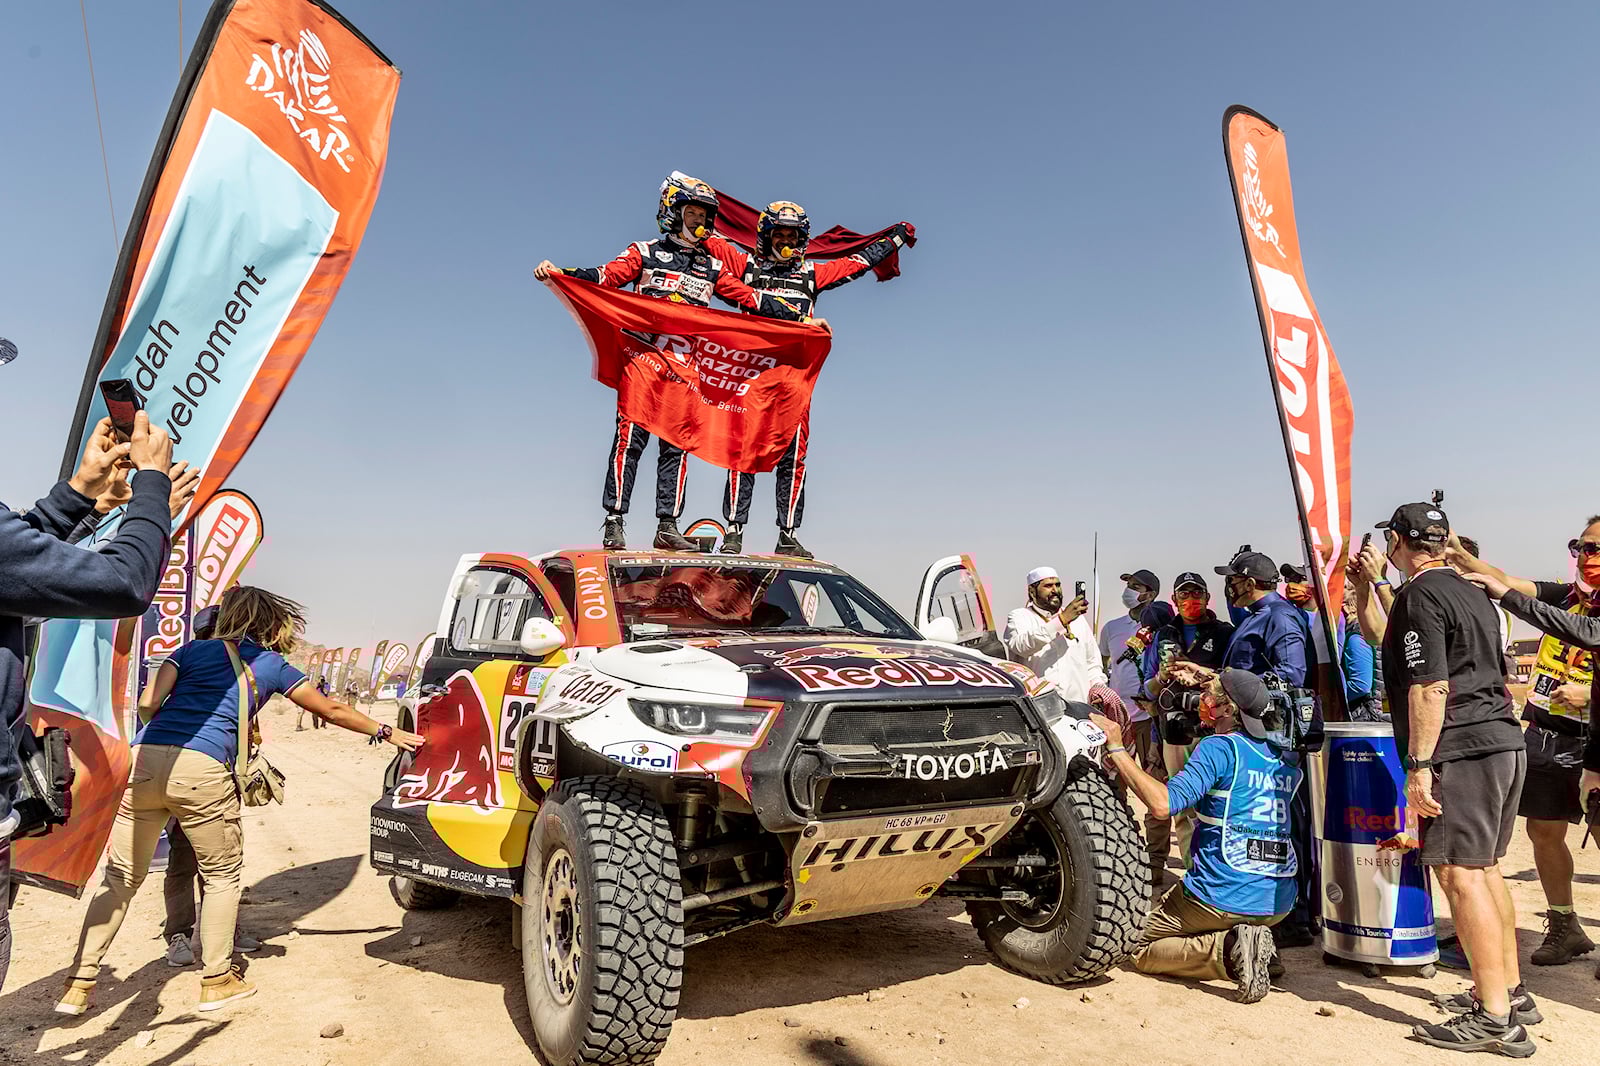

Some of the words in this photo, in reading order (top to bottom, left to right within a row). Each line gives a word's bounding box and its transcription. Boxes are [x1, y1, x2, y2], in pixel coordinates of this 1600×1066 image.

[245, 53, 351, 173] DAKAR
[651, 276, 679, 290] GR
[696, 336, 777, 369] TOYOTA
[623, 346, 662, 372] Pushing
[665, 367, 683, 384] the
[717, 401, 748, 414] Better
[197, 511, 245, 611] MOTUL
[656, 558, 723, 566] TOYOTA
[726, 559, 782, 568] GAZOO
[784, 564, 833, 573] Racing
[559, 674, 625, 706] Qatar
[902, 747, 1008, 781] TOYOTA
[885, 819, 900, 829] HC
[900, 817, 912, 827] 68
[914, 816, 927, 826] WP
[933, 814, 946, 824] GP
[1251, 796, 1287, 824] 28
[803, 824, 1001, 867] HILUX
[450, 869, 485, 883] EDGECAM
